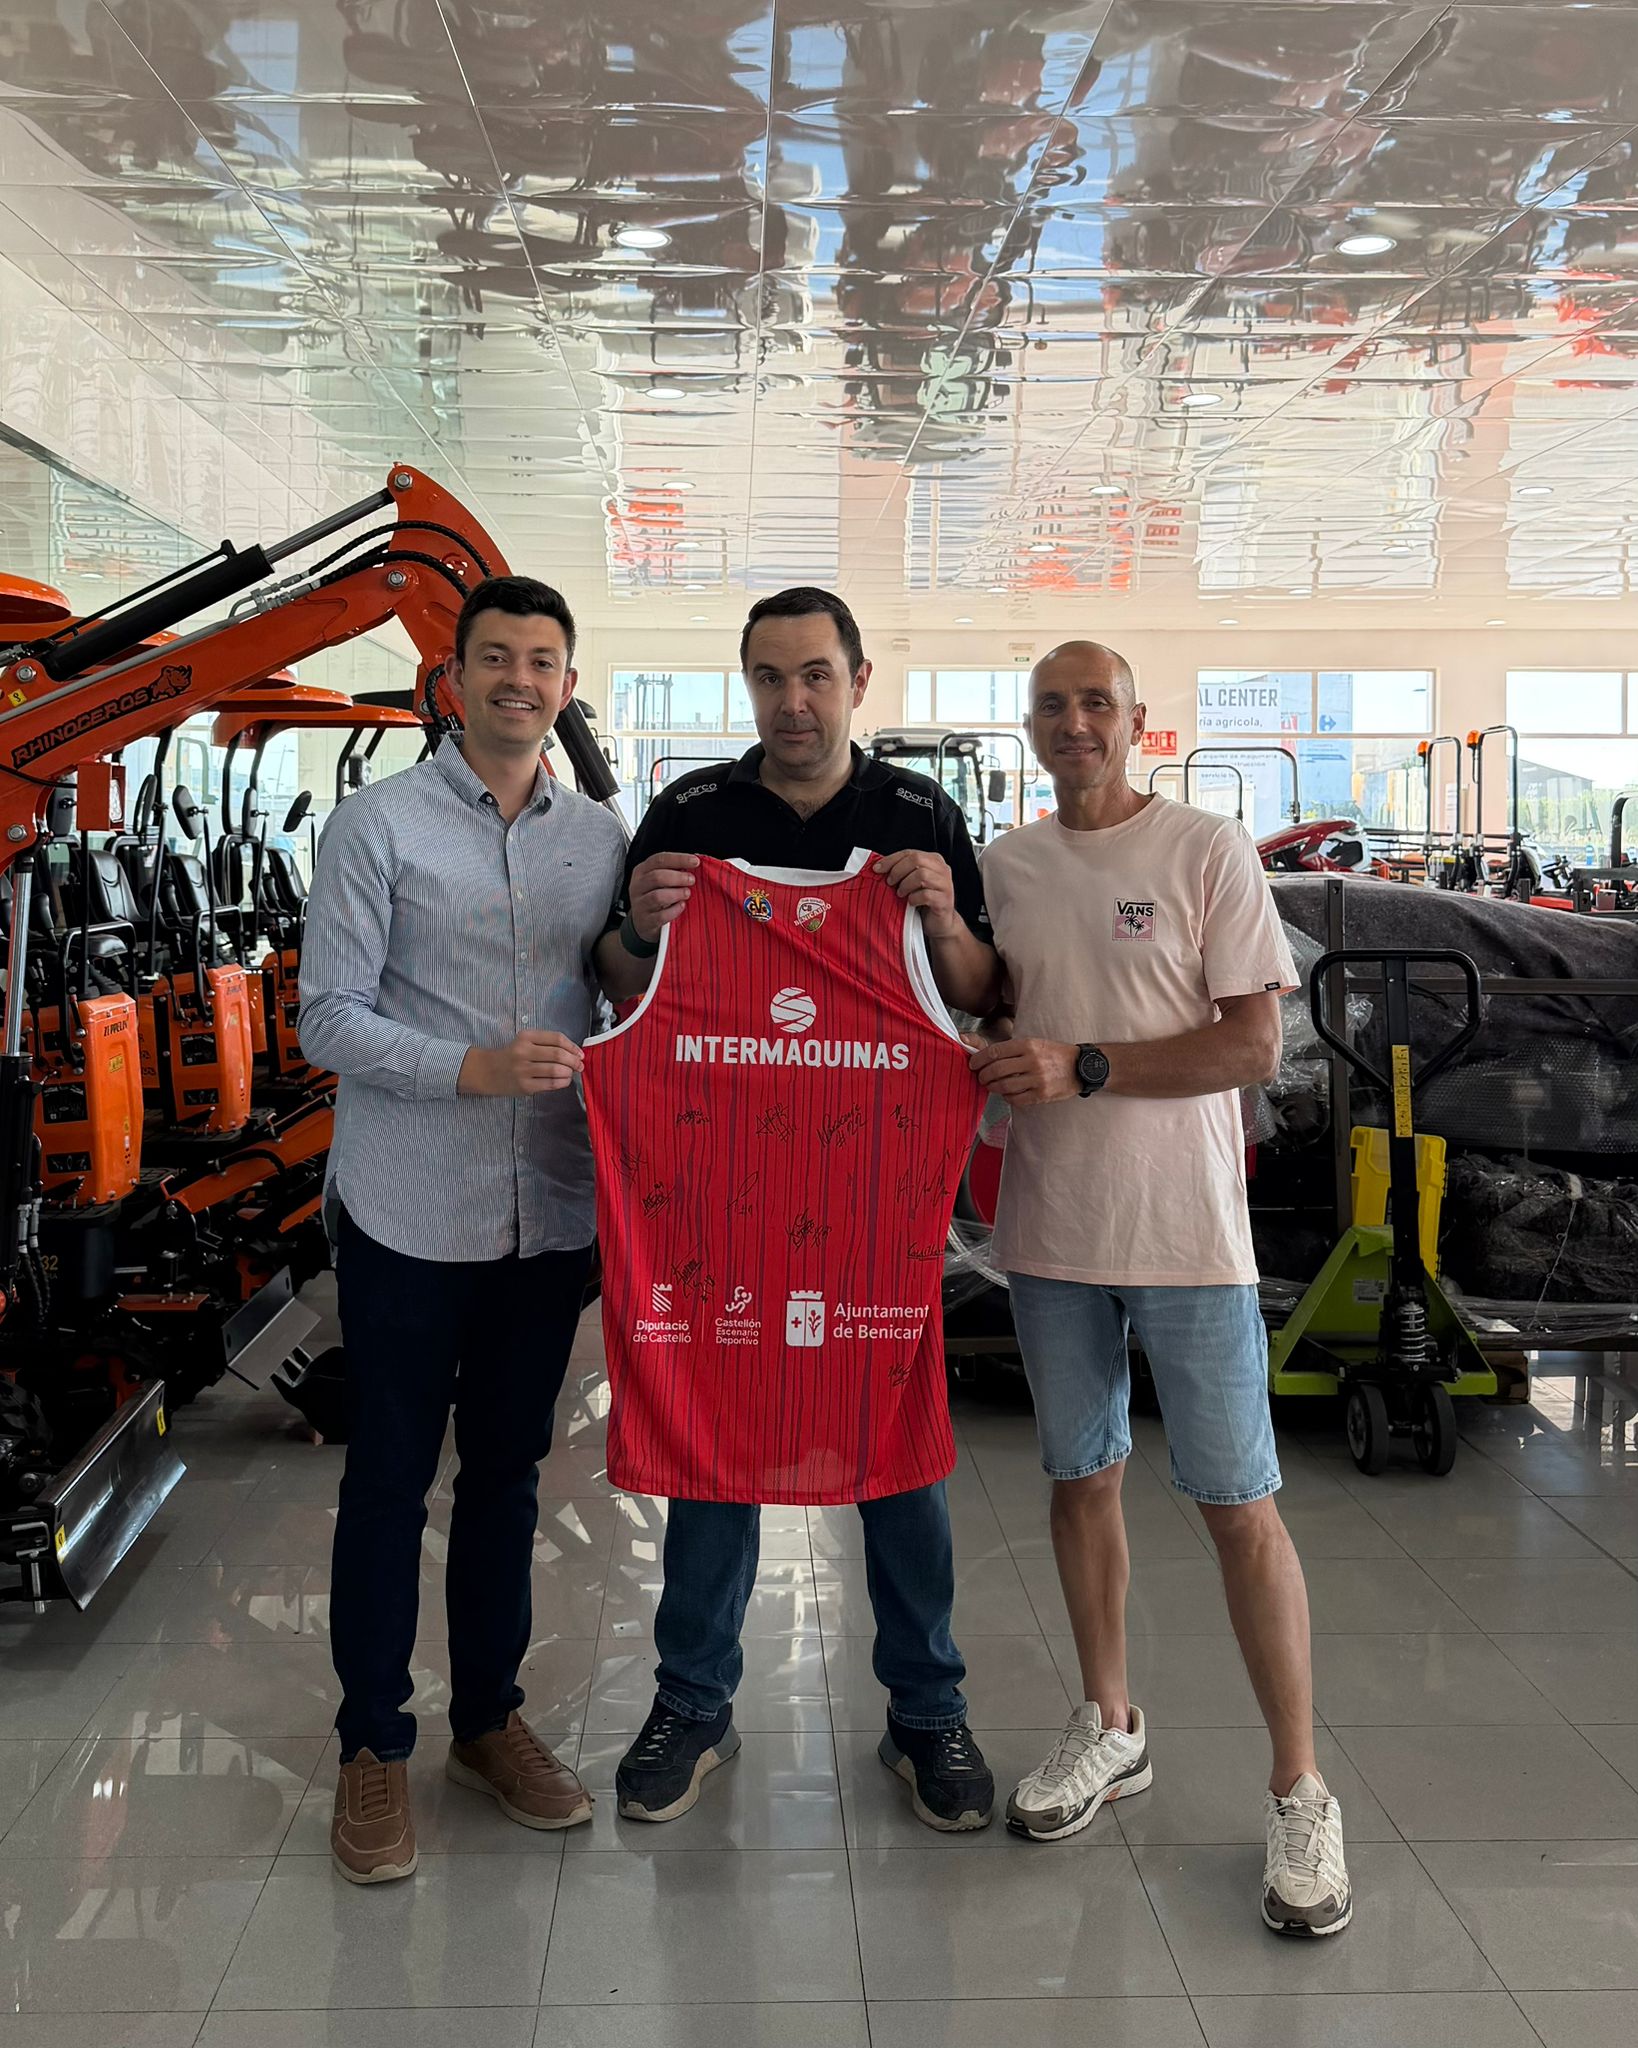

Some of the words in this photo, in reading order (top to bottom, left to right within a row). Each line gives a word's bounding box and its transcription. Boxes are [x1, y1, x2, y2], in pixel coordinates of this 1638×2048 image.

[1218, 688, 1278, 707] CENTER
[14, 689, 149, 765] RHINOCEROS
[676, 783, 718, 804] sparco
[896, 787, 933, 809] sparc
[675, 1034, 910, 1070] INTERMAQUINAS
[833, 1302, 930, 1321] Ajuntament
[636, 1319, 690, 1333] Diputació
[715, 1317, 762, 1329] Castellón
[833, 1323, 853, 1339] de
[858, 1323, 924, 1340] Benicarl
[632, 1332, 648, 1343] de
[649, 1332, 692, 1344] Castelló
[715, 1336, 759, 1346] Deportivo
[716, 1328, 759, 1337] Escenario
